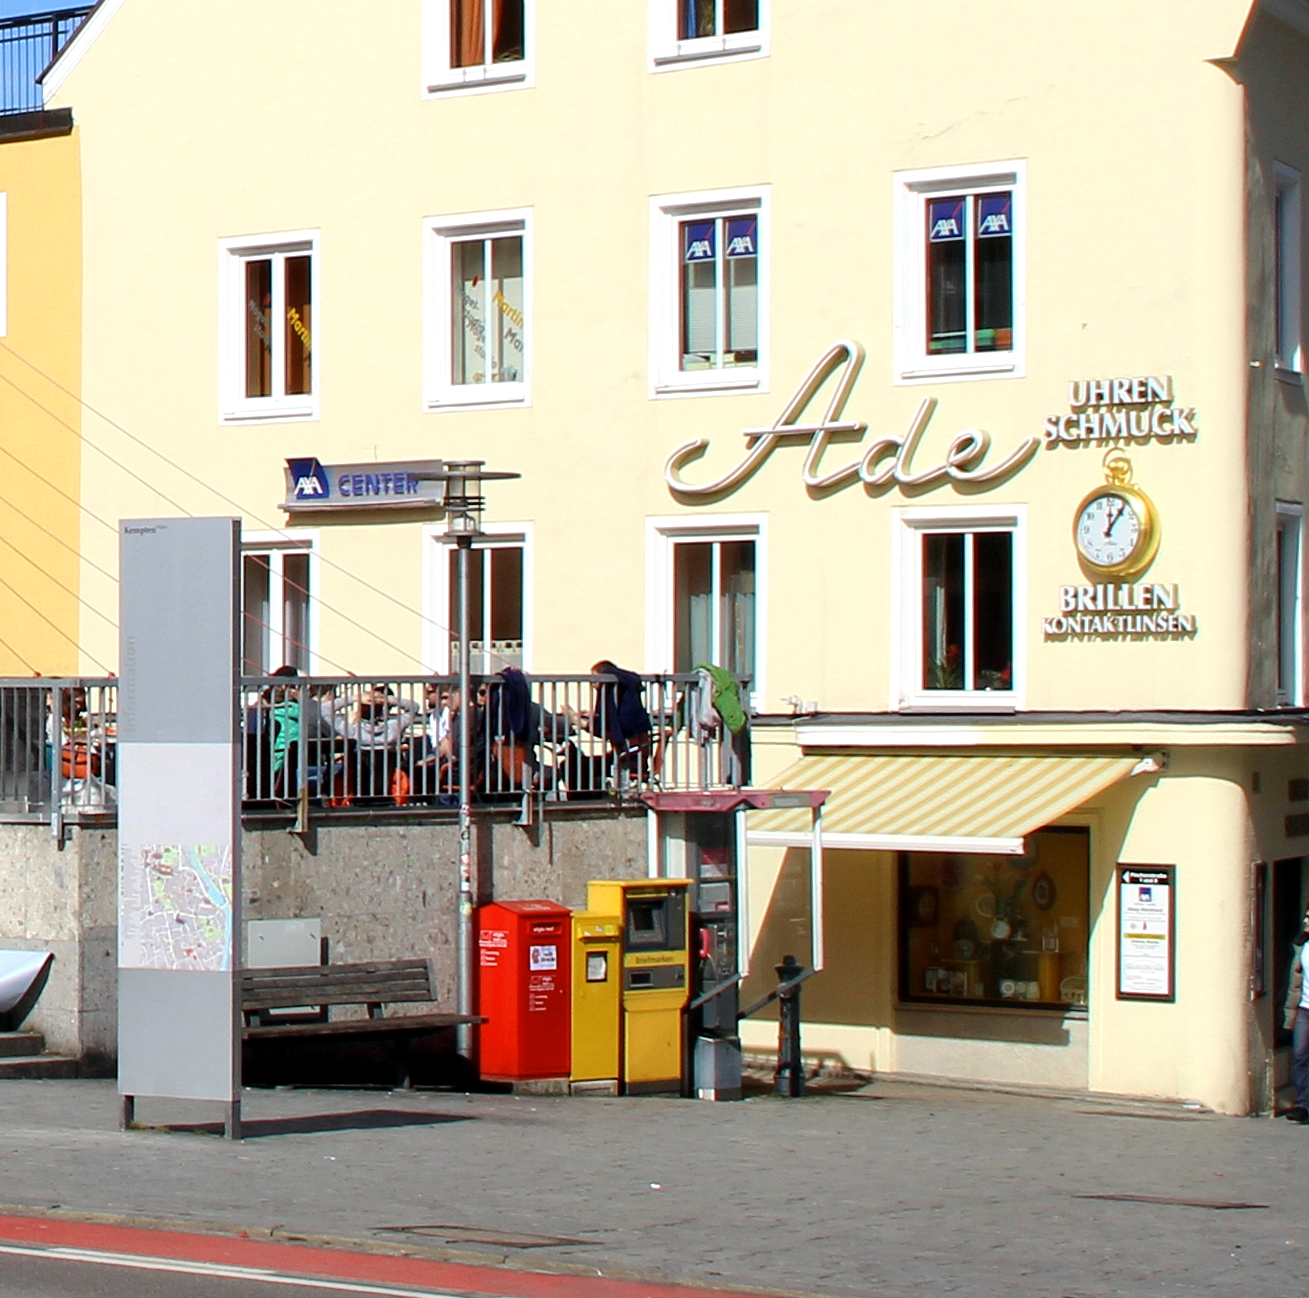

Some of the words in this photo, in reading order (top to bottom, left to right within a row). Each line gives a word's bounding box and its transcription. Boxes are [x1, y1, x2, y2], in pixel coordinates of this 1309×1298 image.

[930, 218, 959, 238] AXA
[979, 213, 1010, 234] AXA
[686, 240, 712, 260] AXA
[726, 236, 754, 256] AXA
[1069, 376, 1169, 407] UHREN
[665, 339, 1038, 494] Ade
[1043, 408, 1195, 442] SCHMUCK
[294, 475, 323, 496] AXA
[338, 472, 419, 497] CENTER
[124, 526, 157, 536] Kempten
[1059, 583, 1176, 612] BRILLEN
[1042, 614, 1193, 635] KONTAKTLINSEN
[123, 635, 136, 733] Information
[635, 954, 674, 965] Briefmarken
